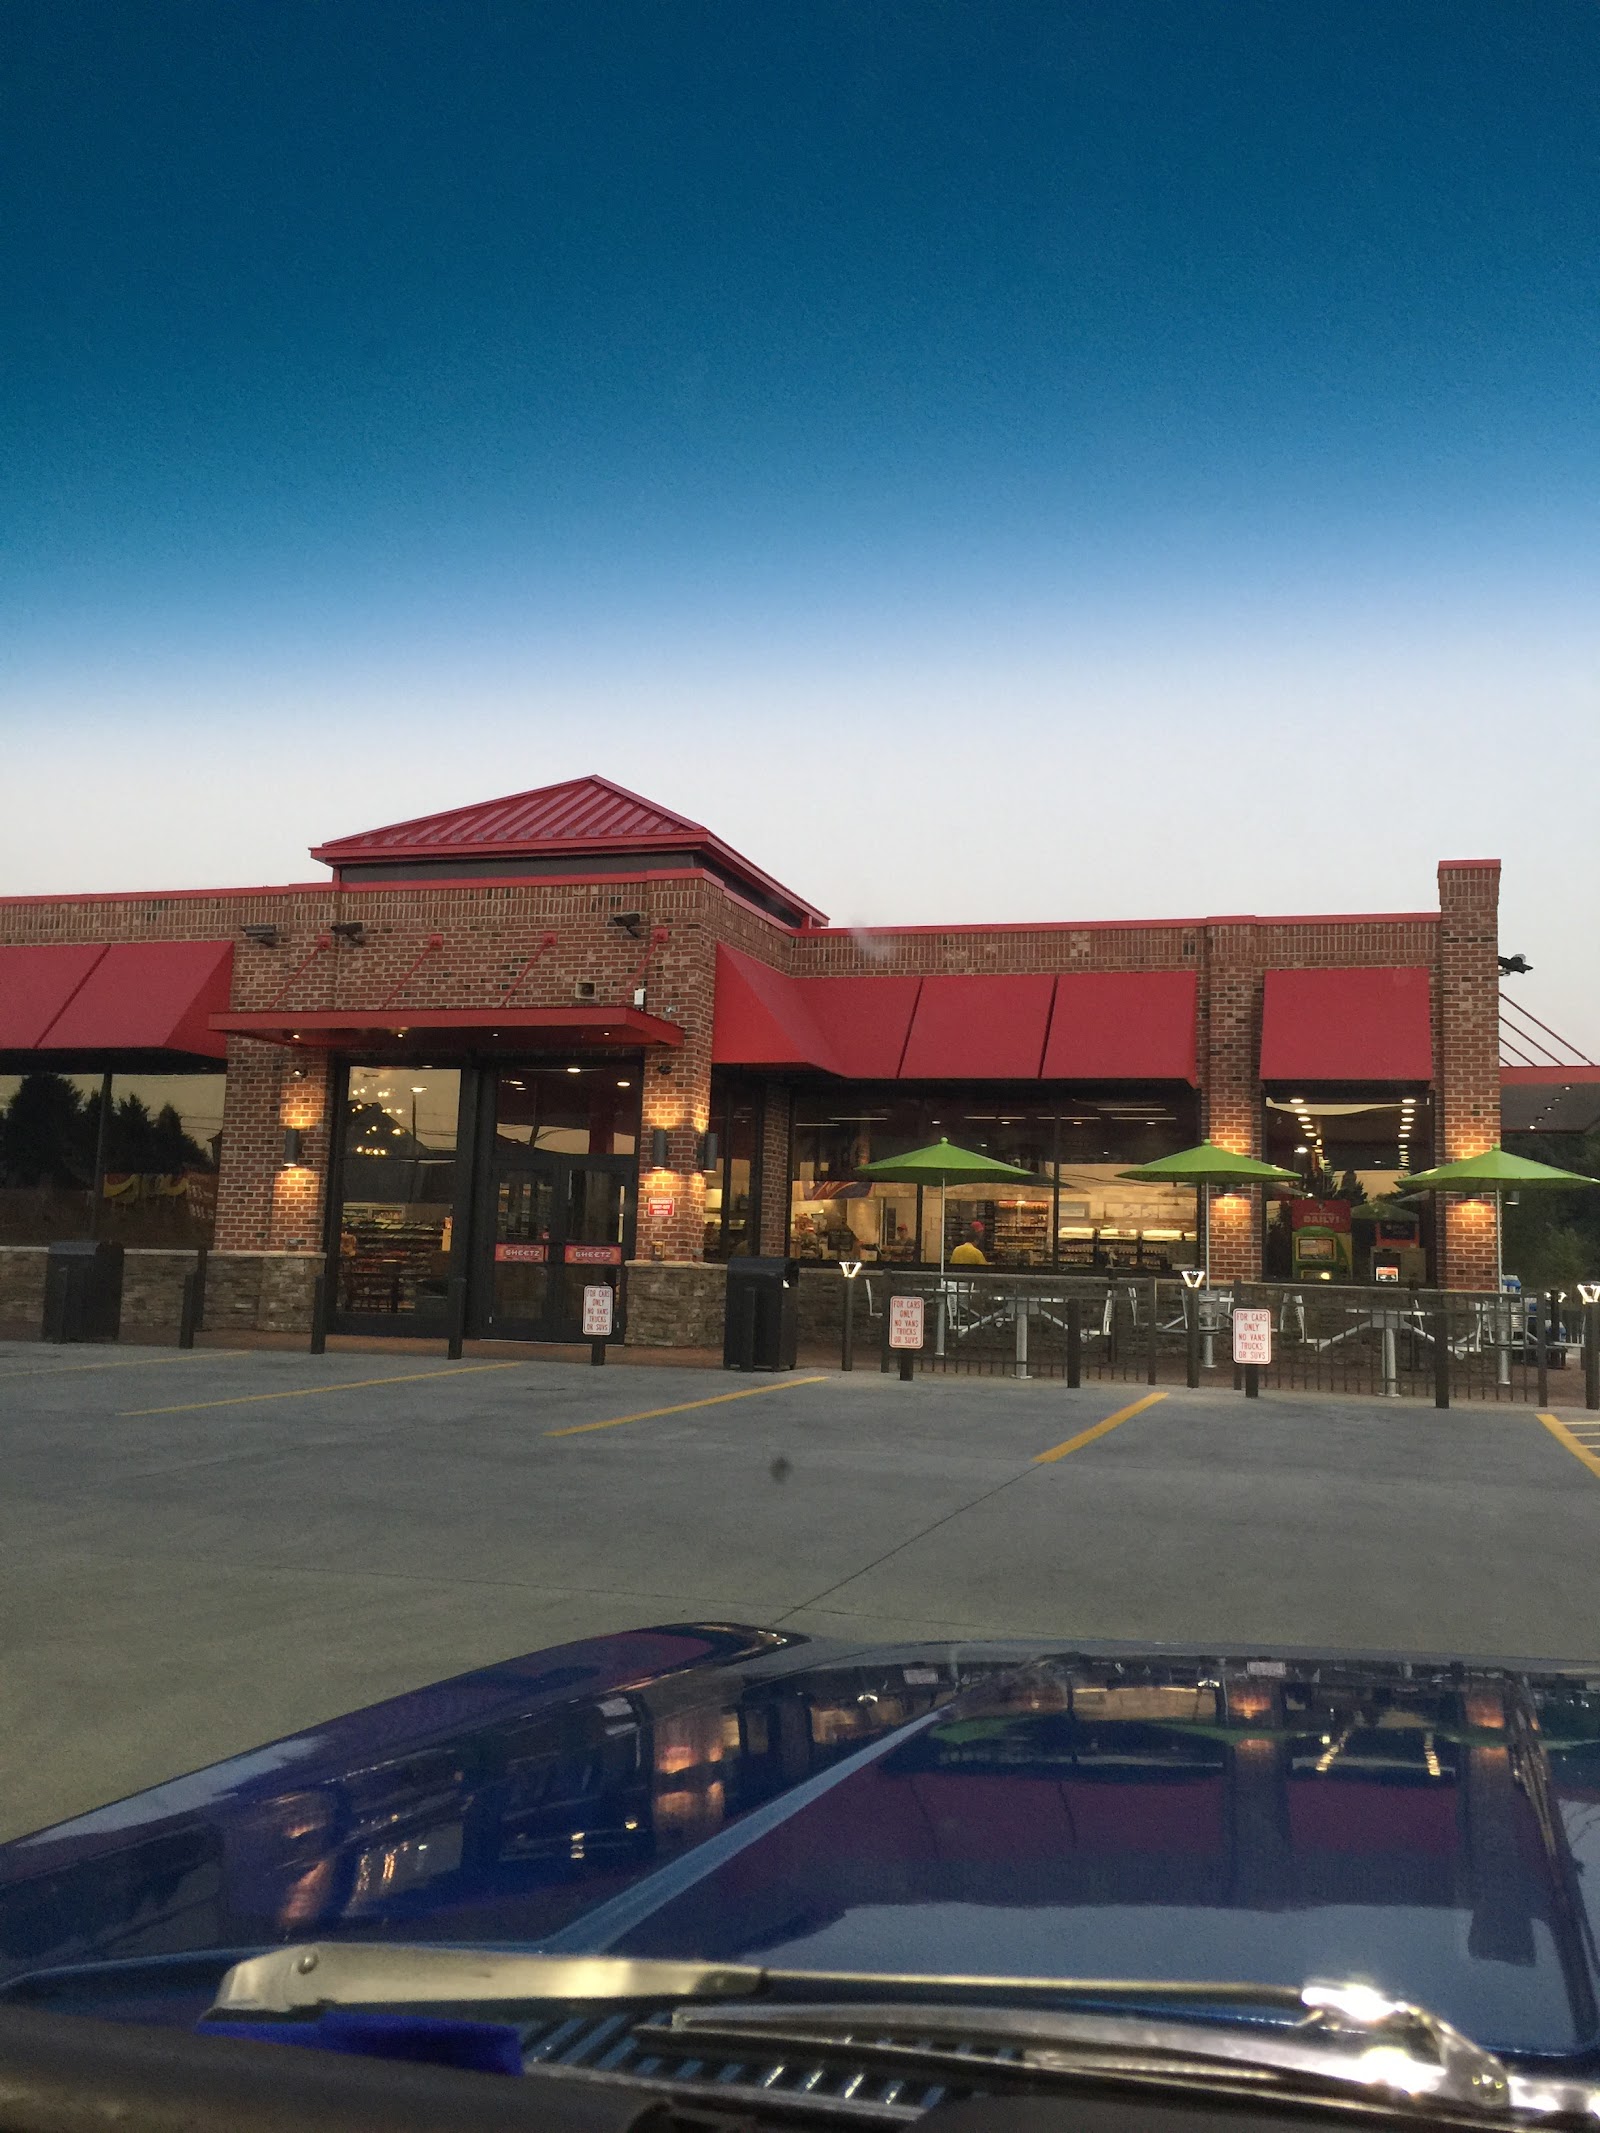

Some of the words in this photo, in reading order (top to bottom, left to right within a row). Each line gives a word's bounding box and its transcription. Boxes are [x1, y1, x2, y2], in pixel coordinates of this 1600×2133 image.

[592, 1298, 604, 1306] ONLY
[893, 1300, 904, 1308] FOR
[907, 1300, 920, 1309] CARS
[900, 1309, 914, 1319] ONLY
[1236, 1312, 1248, 1321] FOR
[1251, 1313, 1267, 1322] CARS
[895, 1319, 902, 1327] NO
[905, 1320, 919, 1328] VANS
[1243, 1322, 1260, 1331] ONLY
[897, 1327, 917, 1336] TRUCKS
[894, 1335, 902, 1344] OR
[1238, 1333, 1247, 1341] NO
[1250, 1334, 1266, 1342] VANS
[1241, 1342, 1264, 1350] TRUCKS
[1238, 1350, 1247, 1359] OR
[1250, 1351, 1266, 1360] SUVS
